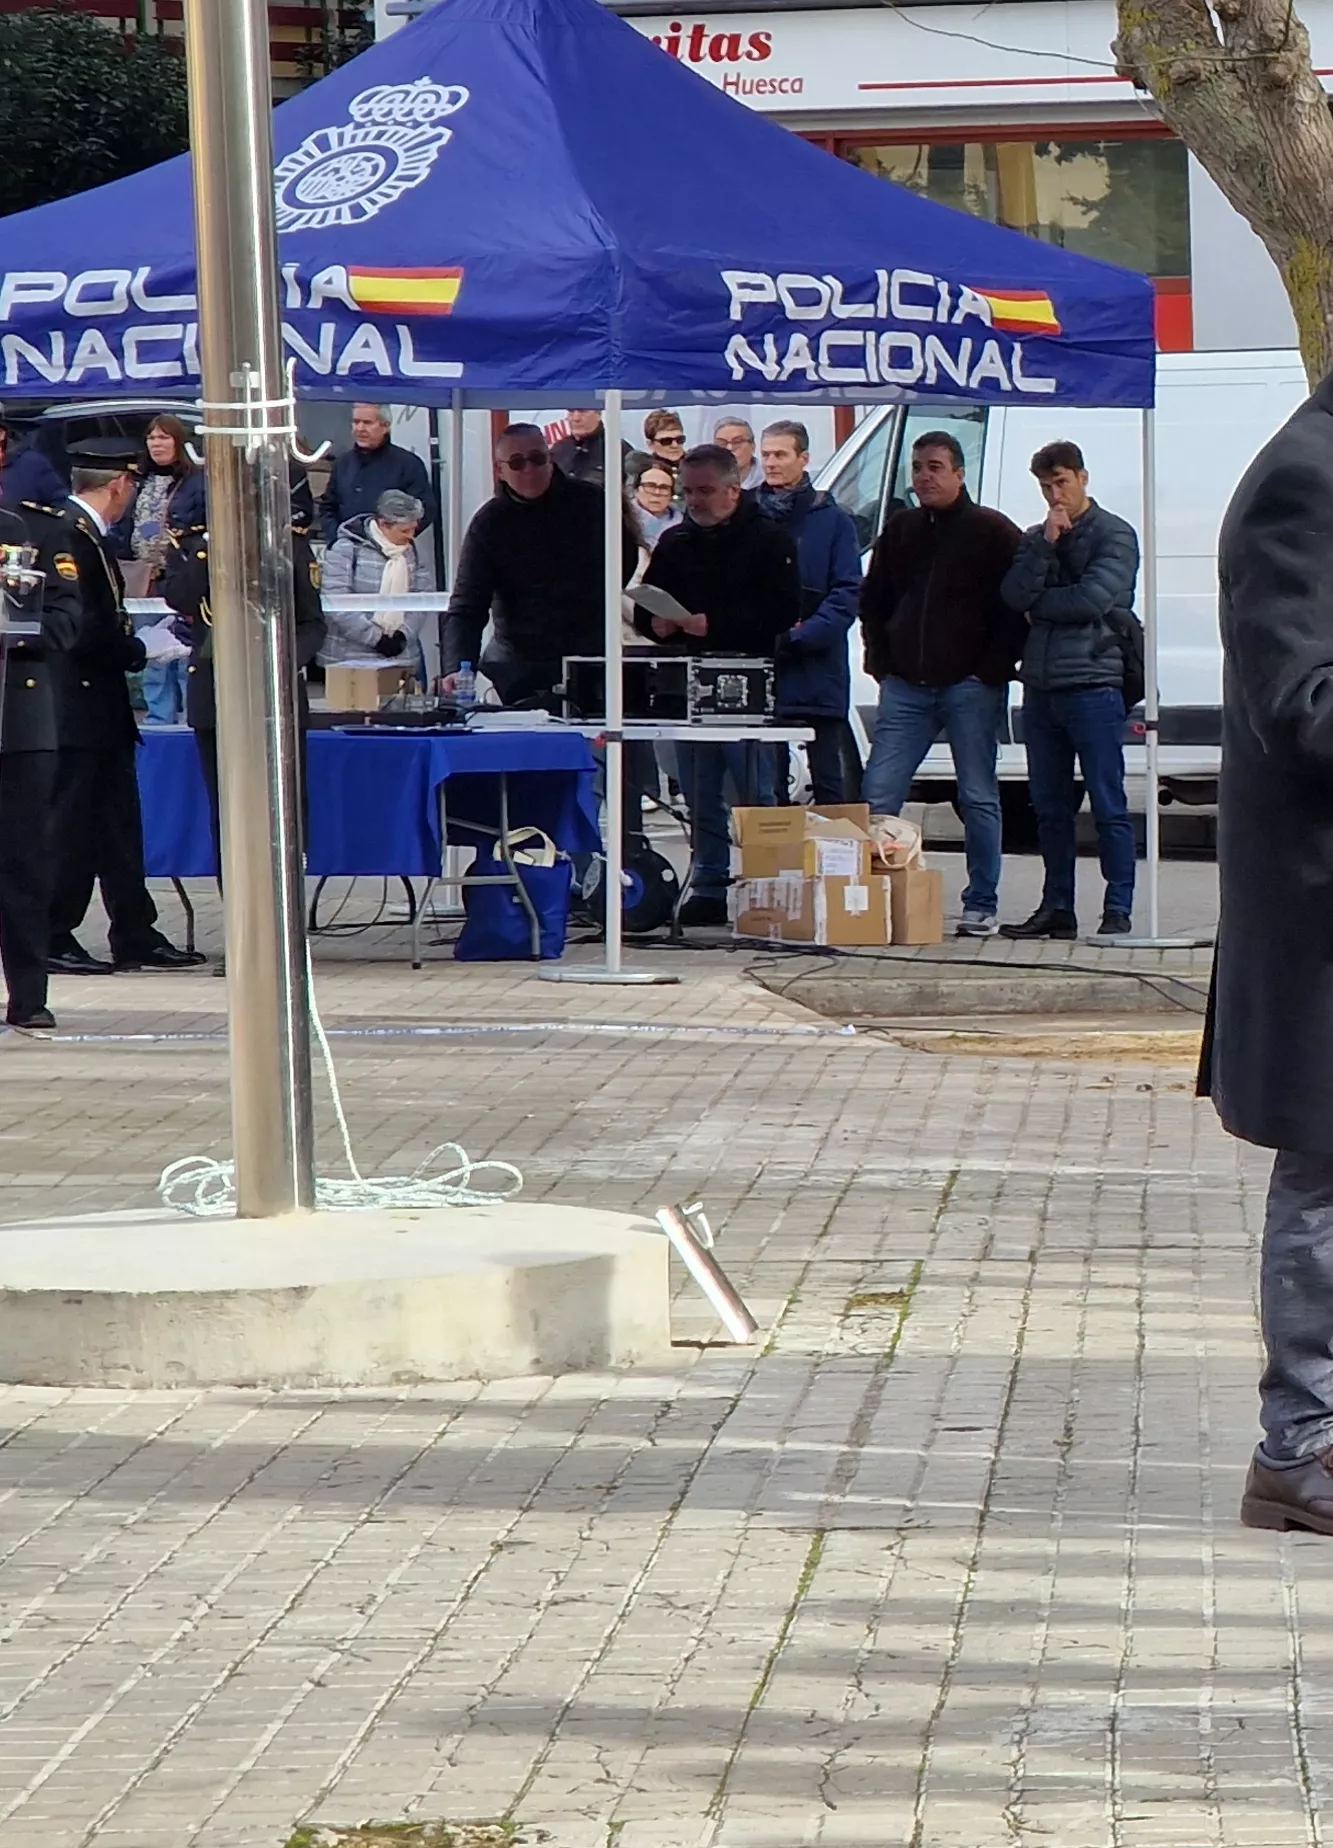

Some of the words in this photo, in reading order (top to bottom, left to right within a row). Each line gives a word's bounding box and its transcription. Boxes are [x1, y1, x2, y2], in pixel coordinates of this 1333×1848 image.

[652, 21, 773, 63] itas
[722, 72, 803, 95] Huesca
[0, 262, 362, 321] POLÍA
[1, 322, 463, 385] NACINAL
[724, 330, 1056, 393] NACIONAL
